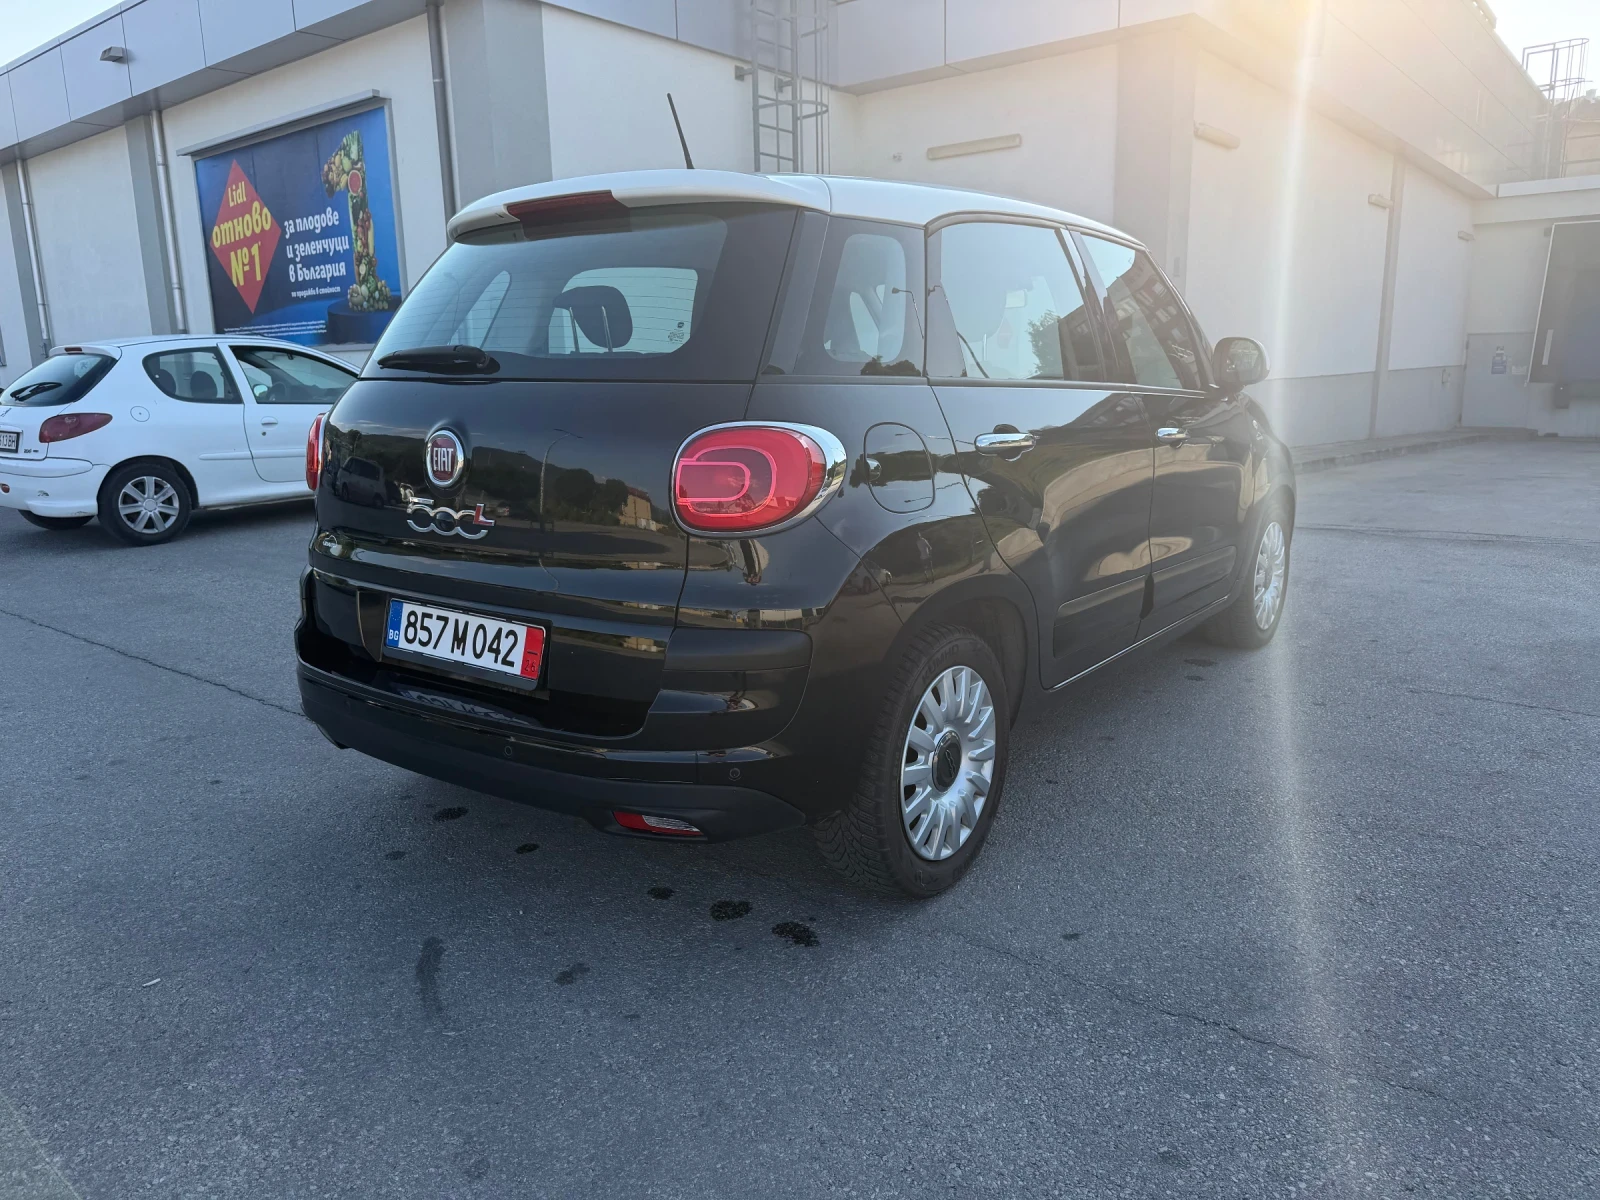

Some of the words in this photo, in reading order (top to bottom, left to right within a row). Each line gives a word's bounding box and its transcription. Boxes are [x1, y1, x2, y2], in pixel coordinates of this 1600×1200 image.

[228, 181, 247, 207] Lidl
[212, 200, 272, 248] отново
[284, 219, 295, 239] за
[295, 206, 340, 233] плодове
[286, 244, 294, 259] и
[294, 235, 350, 262] зеленчуци
[288, 263, 296, 283] в
[296, 261, 347, 283] България
[433, 447, 454, 472] FIAT
[388, 629, 399, 641] BG
[524, 659, 537, 673] 26
